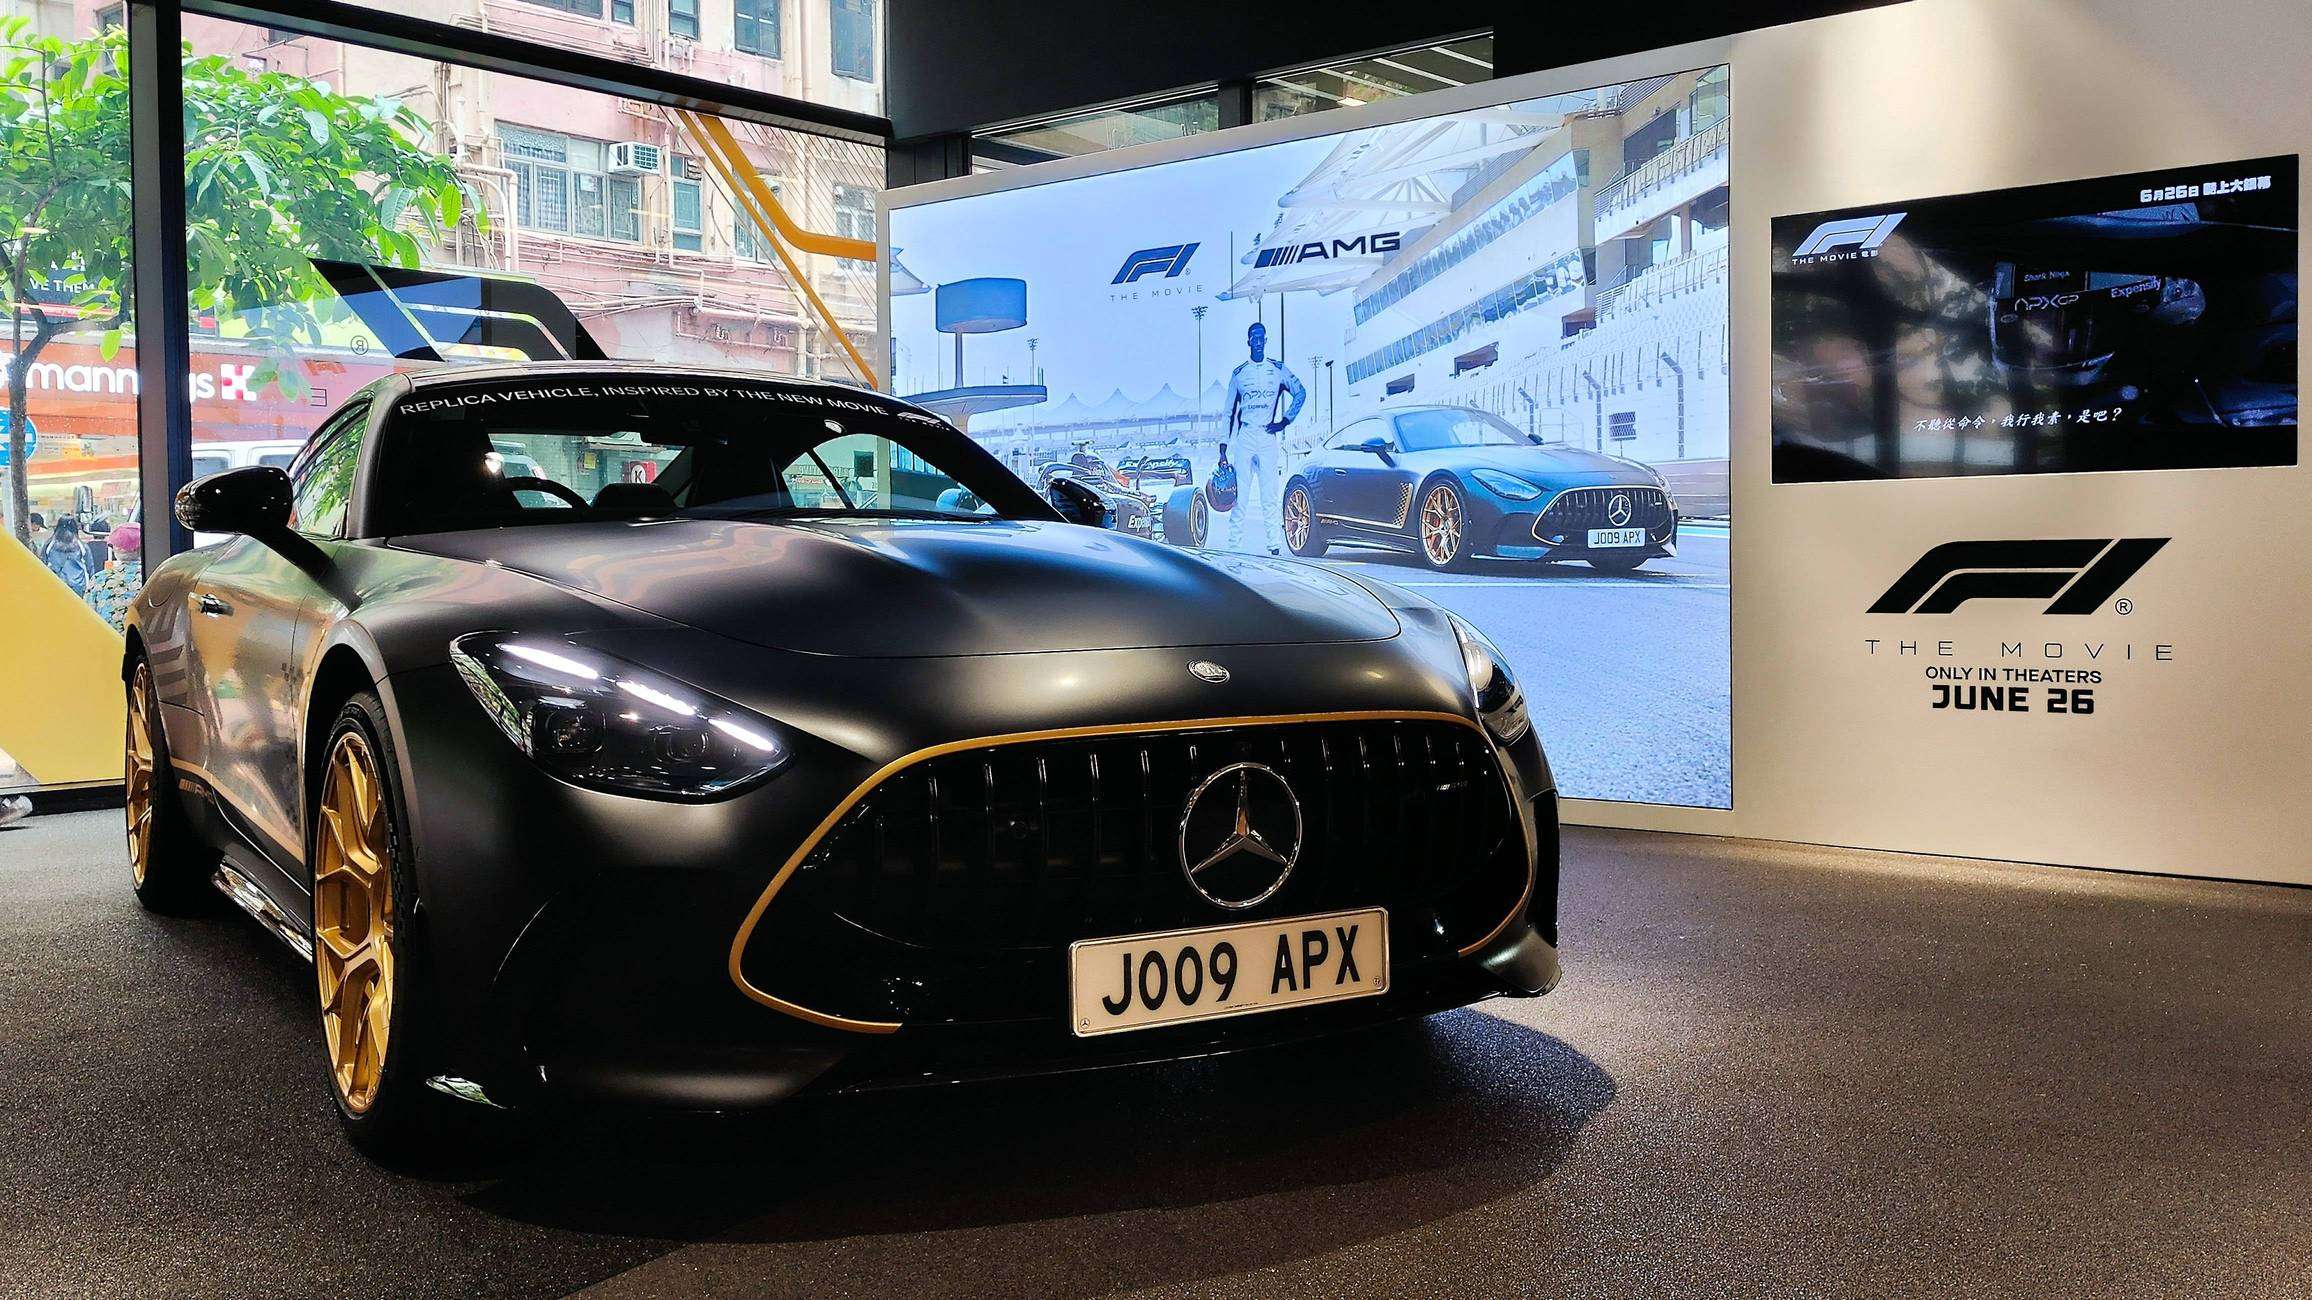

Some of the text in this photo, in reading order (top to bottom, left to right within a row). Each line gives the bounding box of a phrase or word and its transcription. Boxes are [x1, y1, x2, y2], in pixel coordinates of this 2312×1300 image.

[2140, 185, 2199, 202] 6月26日
[1792, 212, 1908, 257] F1
[1296, 232, 1400, 264] AMG
[1792, 257, 1814, 265] THE
[1820, 252, 1857, 262] MOVIE
[1111, 242, 1202, 285] F1
[1110, 285, 1202, 301] THE MOVIE
[2111, 276, 2162, 298] Expensify
[400, 385, 890, 416] REPLICA VEHICLE, INSPIRED BY THE NEW MOVIE
[1594, 530, 1641, 544] J009 APX
[1865, 537, 2173, 615] F1
[1865, 639, 2173, 661] THE MOVIE
[1925, 666, 2102, 684] ONLY IN THEATERS
[1932, 684, 2095, 714] JUNE 26
[1102, 924, 1361, 1016] J009 APX
